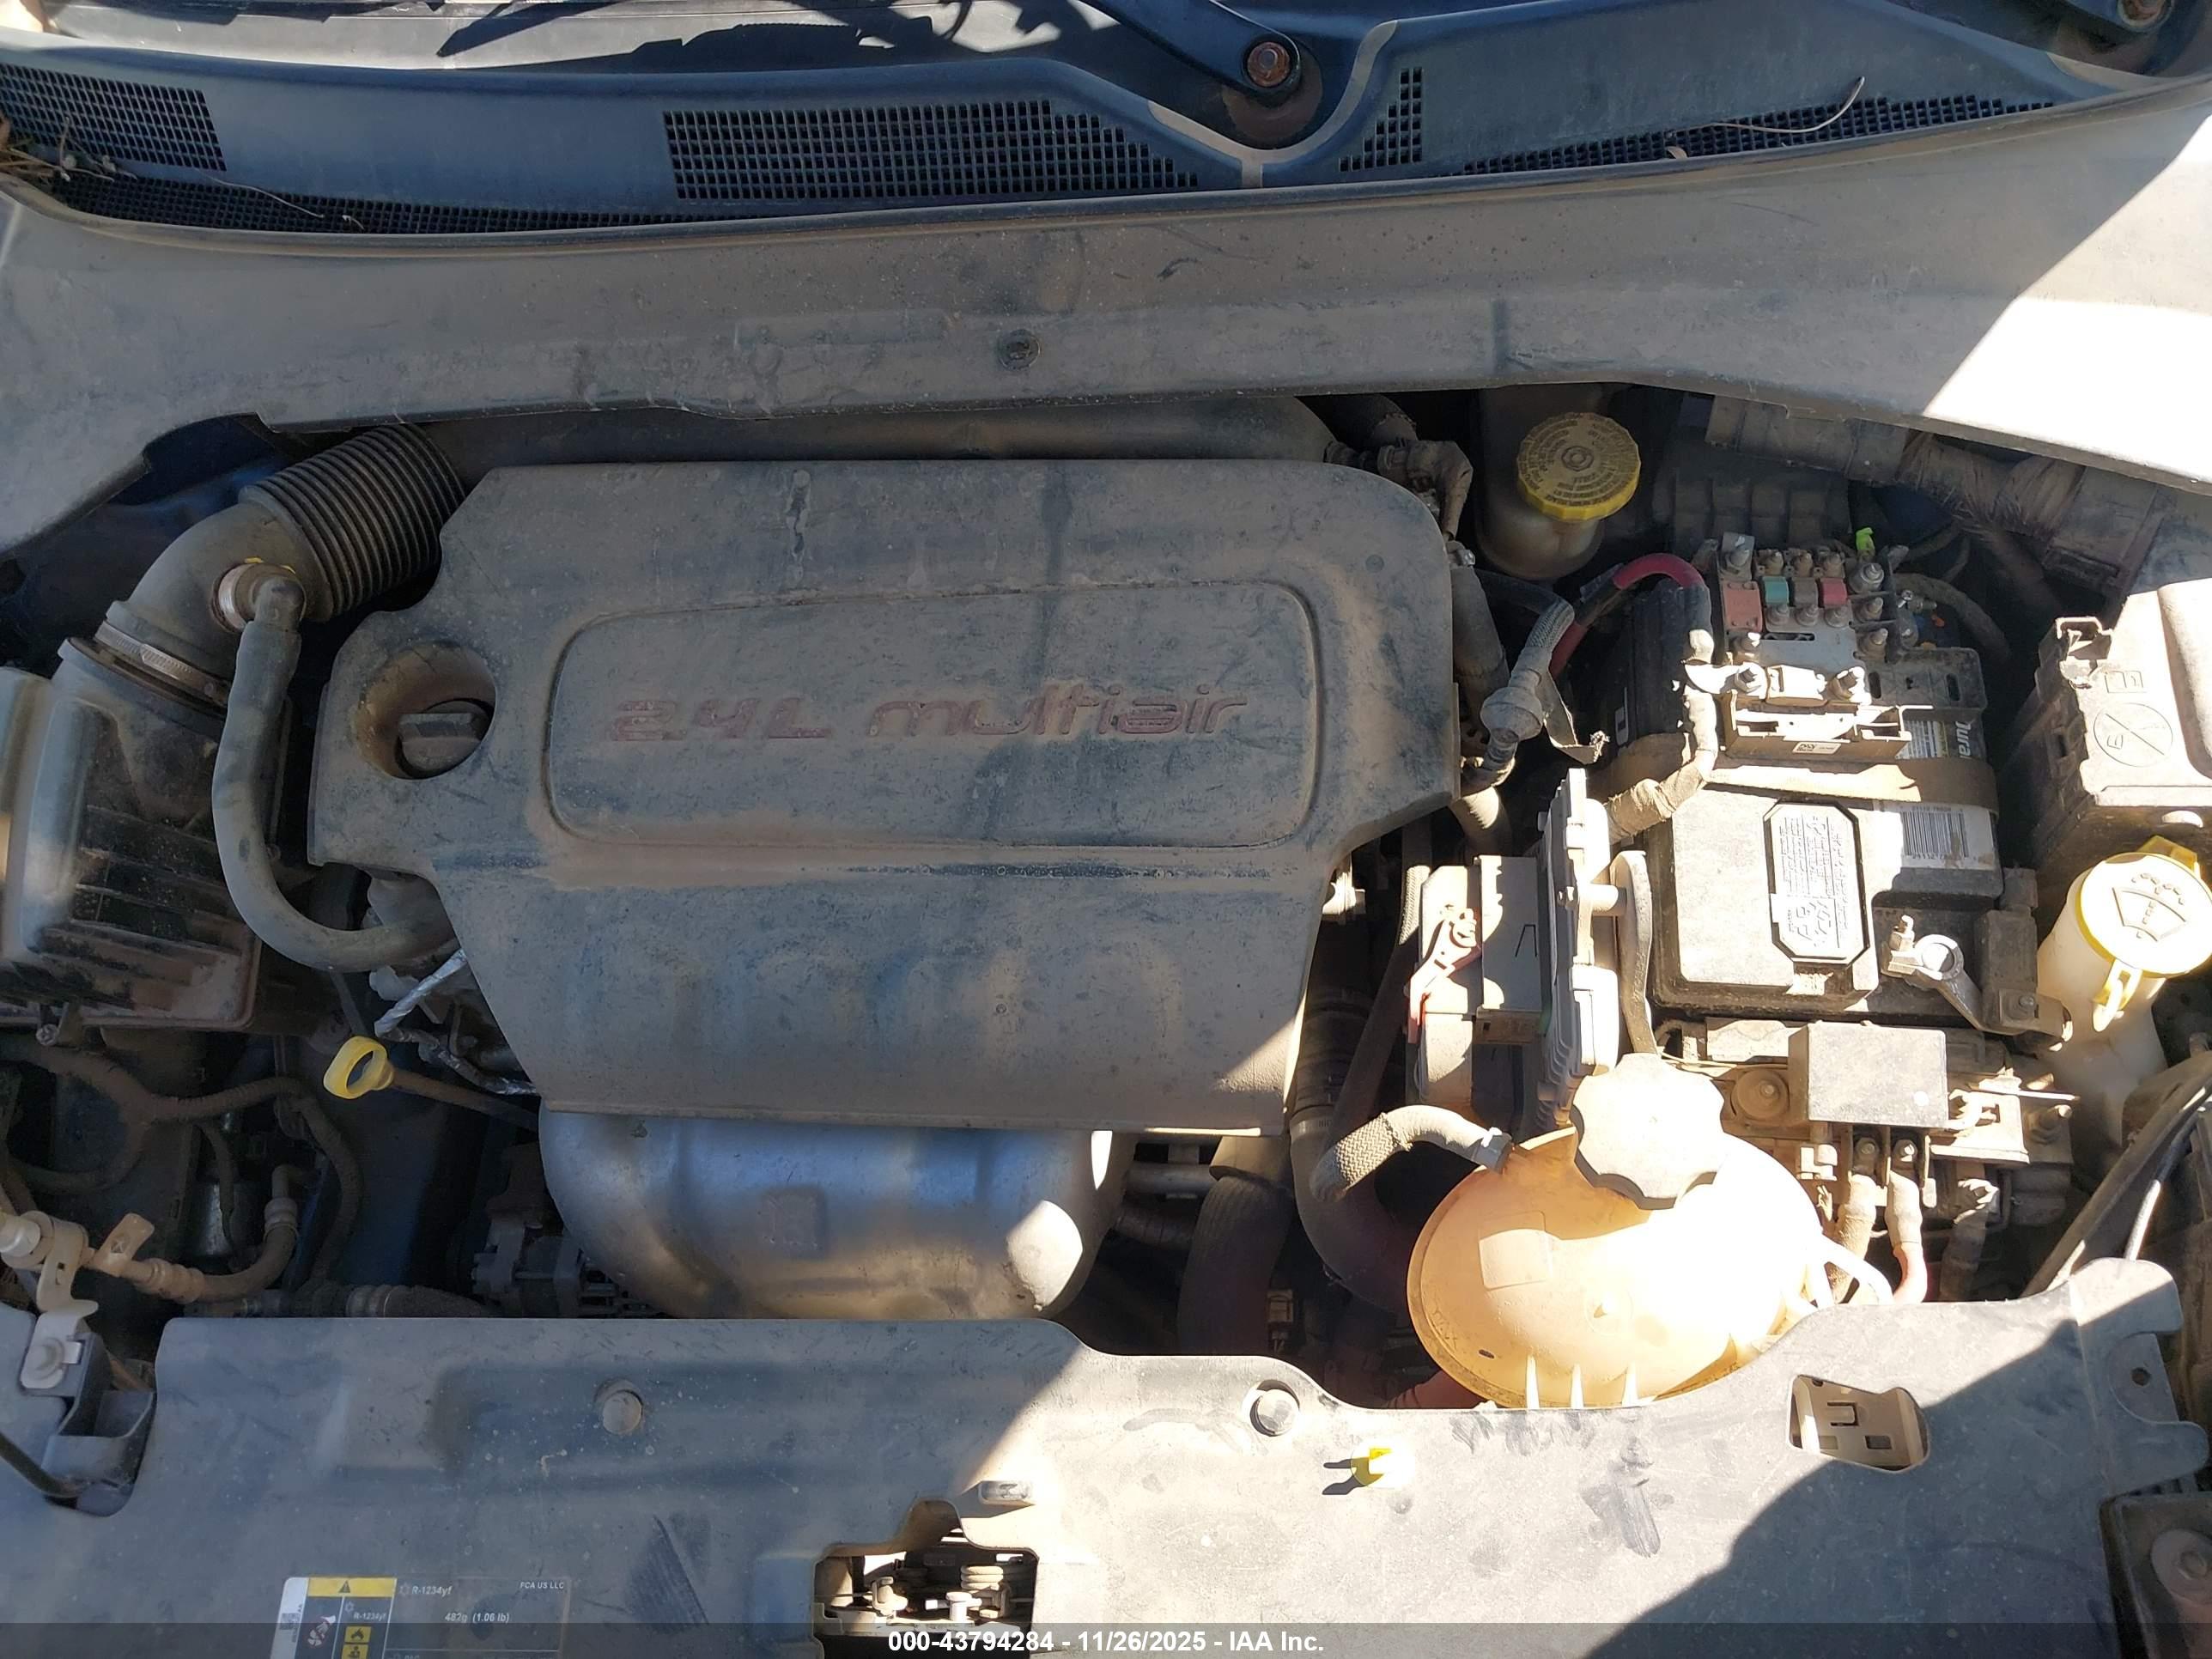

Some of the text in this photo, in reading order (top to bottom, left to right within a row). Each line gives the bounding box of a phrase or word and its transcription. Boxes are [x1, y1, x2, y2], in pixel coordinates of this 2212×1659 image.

[411, 1585, 453, 1597] R-1234yf
[520, 1581, 564, 1589] FCA US LLC
[472, 1612, 495, 1624] (1.06
[496, 1612, 510, 1624] lb)
